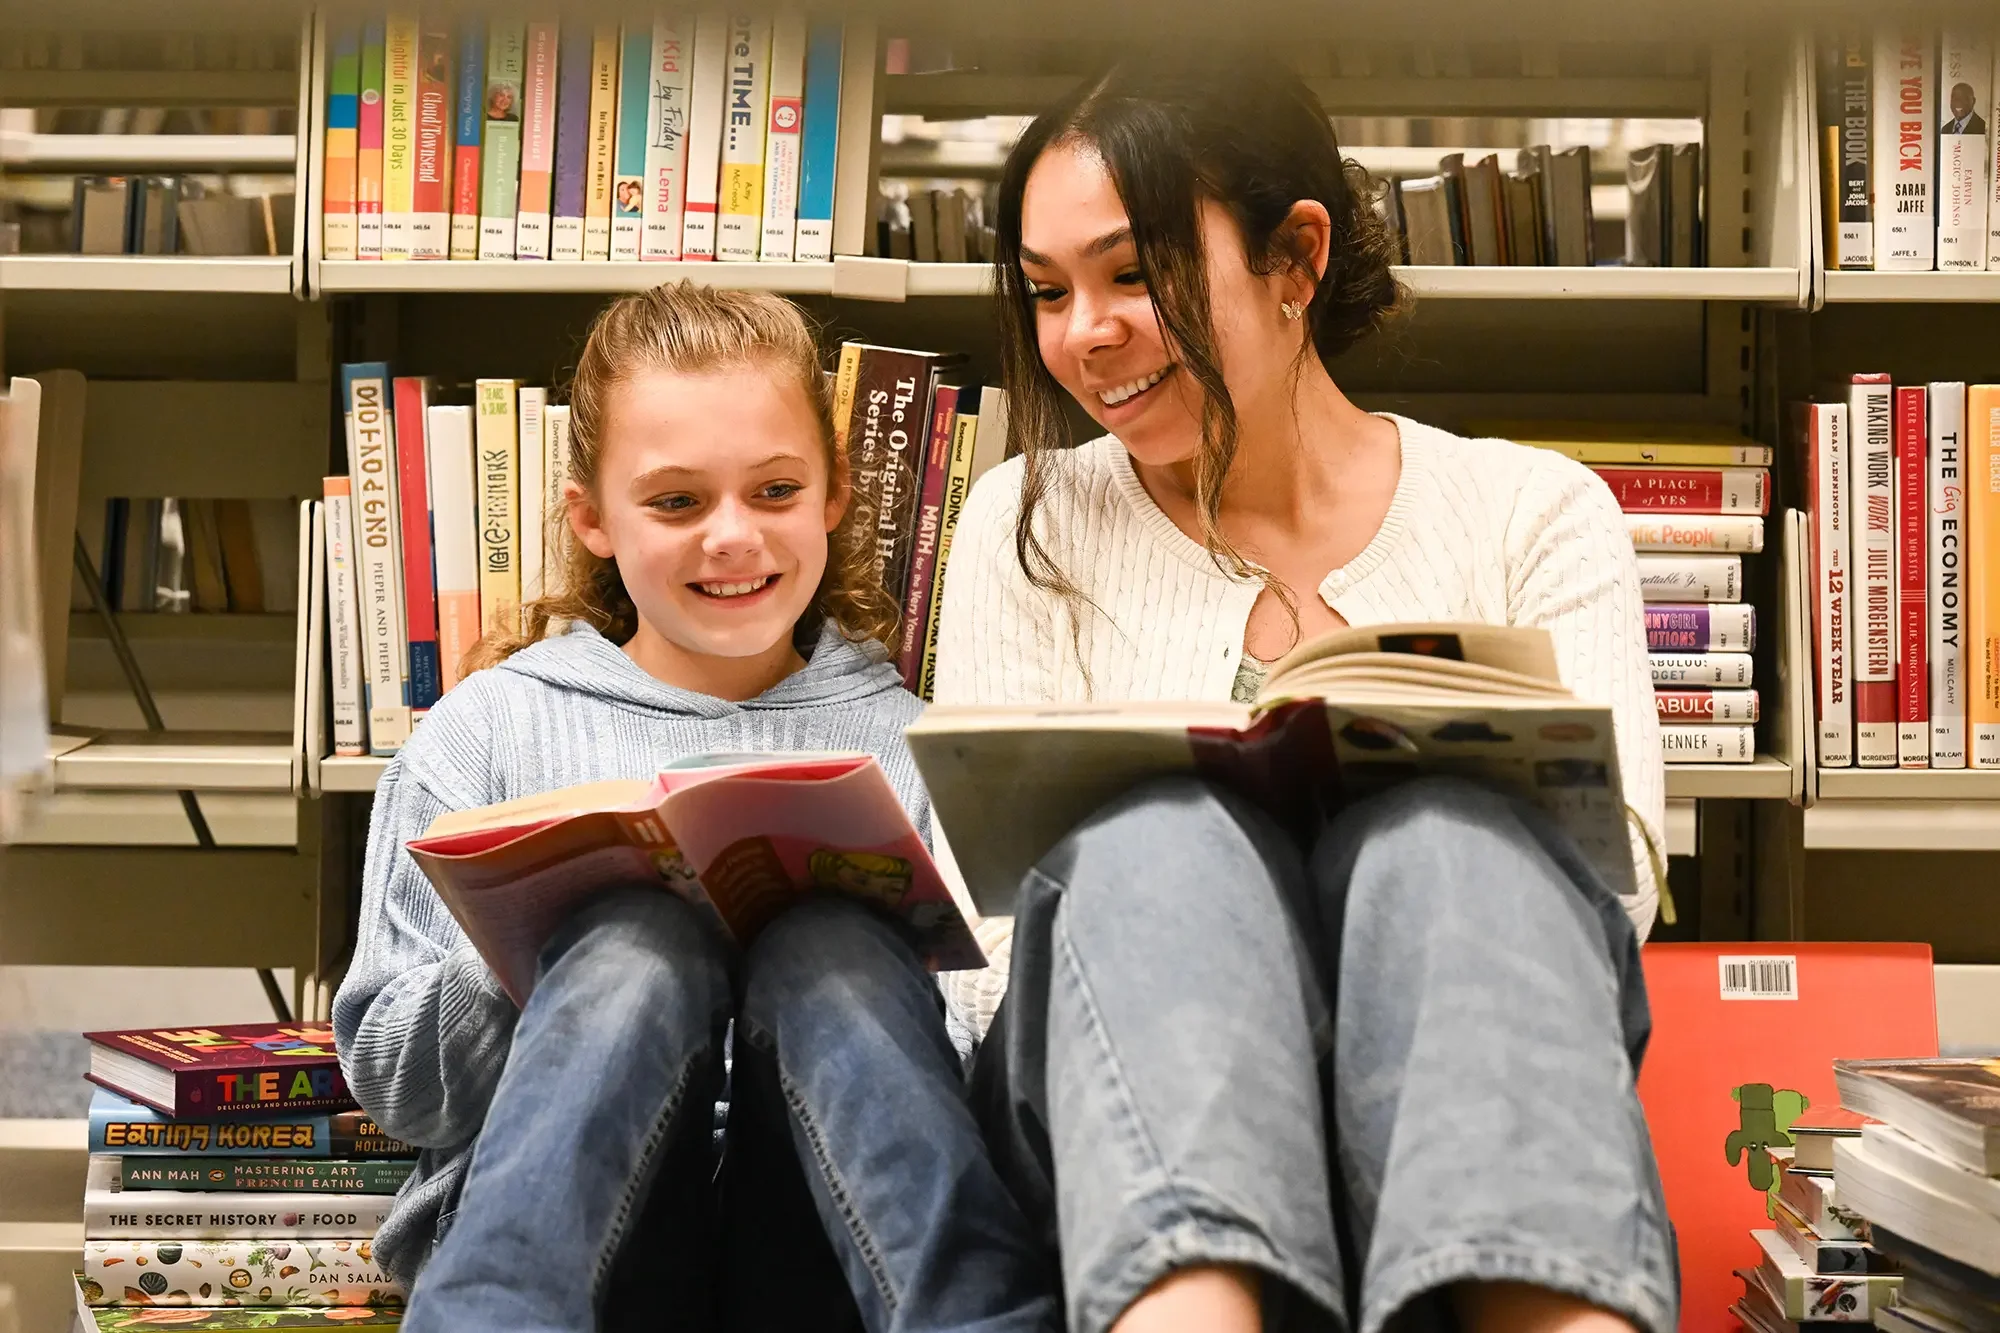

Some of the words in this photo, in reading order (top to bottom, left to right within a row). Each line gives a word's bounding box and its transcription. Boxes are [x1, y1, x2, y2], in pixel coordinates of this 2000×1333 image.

[662, 39, 681, 73] Kid
[393, 84, 406, 95] in
[653, 85, 684, 101] by
[1846, 79, 1867, 111] THE
[1899, 76, 1923, 115] YOU
[393, 98, 406, 122] Just
[393, 126, 406, 140] 30
[419, 92, 442, 183] Cloud/Townsend
[652, 106, 683, 151] Friday
[1846, 116, 1867, 166] BOOK
[391, 144, 406, 171] Days
[1899, 121, 1923, 172] BACK
[1895, 183, 1926, 197] SARAH
[1964, 169, 1973, 206] EARVIN
[1896, 200, 1925, 213] JAFFE
[892, 377, 916, 423] The
[1907, 393, 1918, 424] NEVER
[861, 389, 889, 463] Series
[1831, 414, 1839, 453] MORAN
[1867, 394, 1889, 445] MAKING
[551, 419, 561, 460] Lawrence
[955, 421, 968, 462] Rosemond
[1907, 428, 1918, 458] CHECK
[1941, 432, 1958, 479] THE
[878, 429, 908, 530] Original
[1633, 478, 1642, 489] A
[1648, 478, 1697, 490] PLACE
[1867, 450, 1889, 488] WORK
[946, 476, 965, 529] ENDING
[1642, 495, 1653, 506] of
[1659, 495, 1687, 506] YES
[1867, 494, 1889, 534] WORK
[1933, 486, 1962, 514] Gig
[917, 504, 939, 555] MATH
[1907, 516, 1918, 533] THE
[914, 556, 925, 571] for
[1867, 548, 1889, 580] JULIE
[373, 561, 386, 604] PIEPER
[912, 573, 923, 588] the
[1828, 569, 1844, 594] 12
[1941, 519, 1958, 649] ECONOMY
[908, 590, 923, 615] Very
[375, 608, 388, 637] AND
[903, 617, 920, 653] Young
[1830, 597, 1843, 653] WEEK
[1867, 585, 1889, 676] MORGENSTERN
[1908, 610, 1918, 640] JULIE
[378, 642, 390, 684] PIEPER
[1831, 655, 1843, 705] YEAR
[1909, 643, 1918, 721] MORGENSTERN
[1947, 658, 1955, 705] MULCAHY
[216, 1071, 280, 1103] THE
[217, 1103, 261, 1111] DELICIOUS
[283, 1099, 335, 1108] DISTINCTIVE
[130, 1170, 162, 1181] ANN
[168, 1170, 200, 1181] MAH
[234, 1166, 315, 1176] MASTERING
[330, 1167, 357, 1176] ART
[235, 1178, 304, 1188] FRENCH
[312, 1179, 365, 1189] EATING
[109, 1214, 138, 1226] THE
[145, 1214, 203, 1226] SECRET
[210, 1214, 277, 1226] HISTORY
[313, 1213, 357, 1225] FOOD
[309, 1273, 339, 1283] DAN
